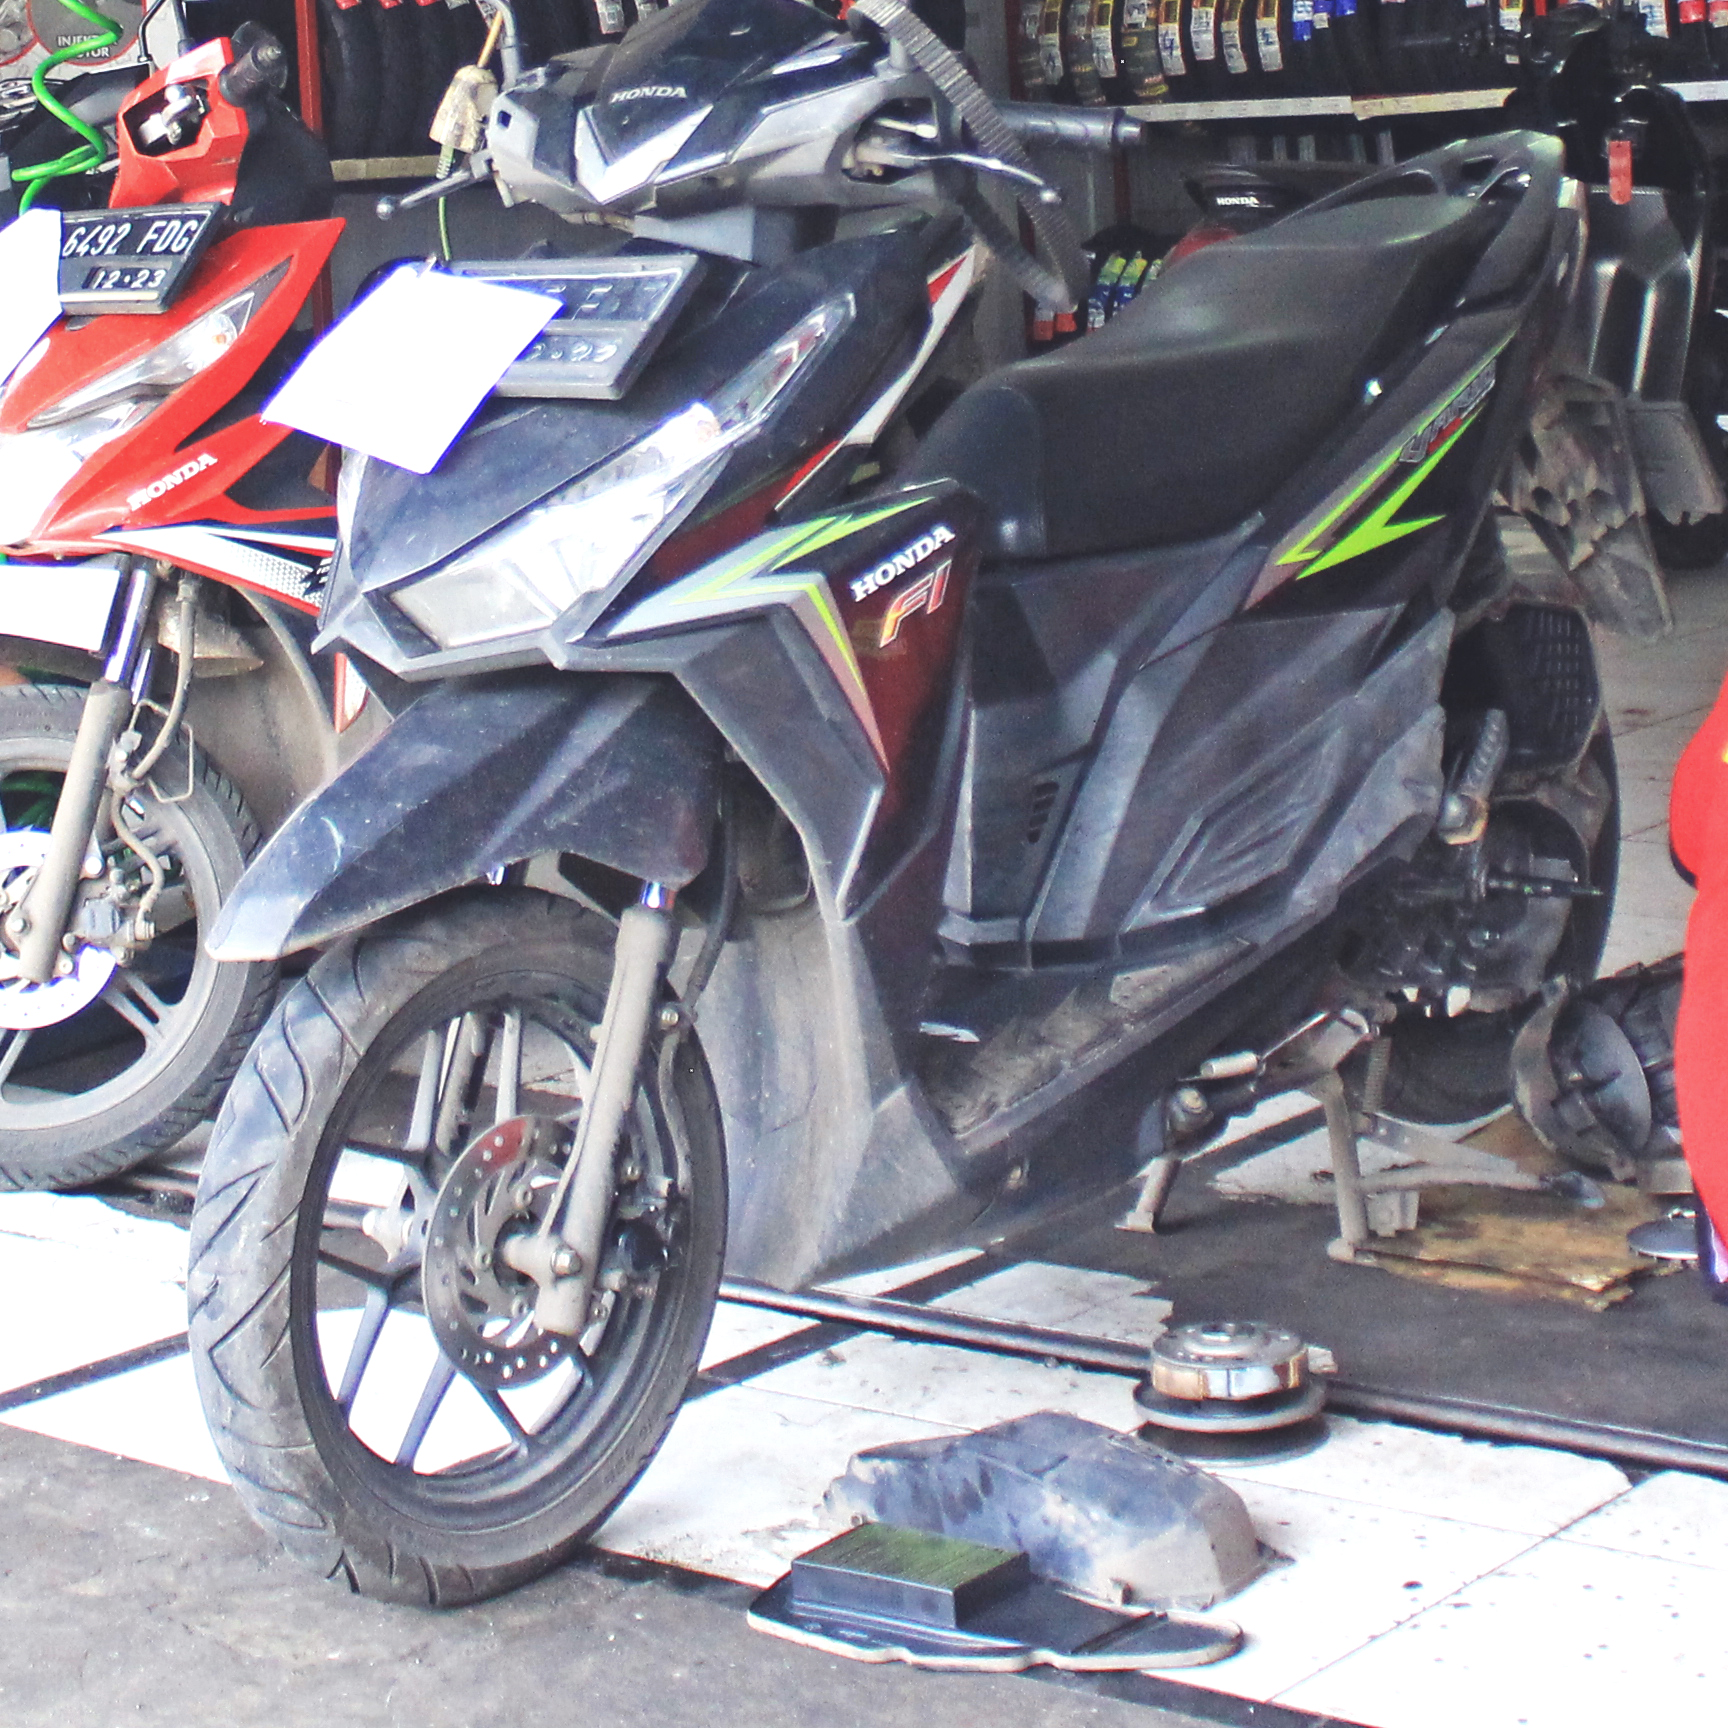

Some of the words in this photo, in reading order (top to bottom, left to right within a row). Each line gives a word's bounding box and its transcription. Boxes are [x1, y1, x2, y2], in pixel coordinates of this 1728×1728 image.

[609, 87, 687, 103] HONDA
[1216, 197, 1260, 207] HONDA
[63, 223, 132, 256] 6492
[126, 452, 218, 511] HONDA
[850, 526, 956, 602] HONDA
